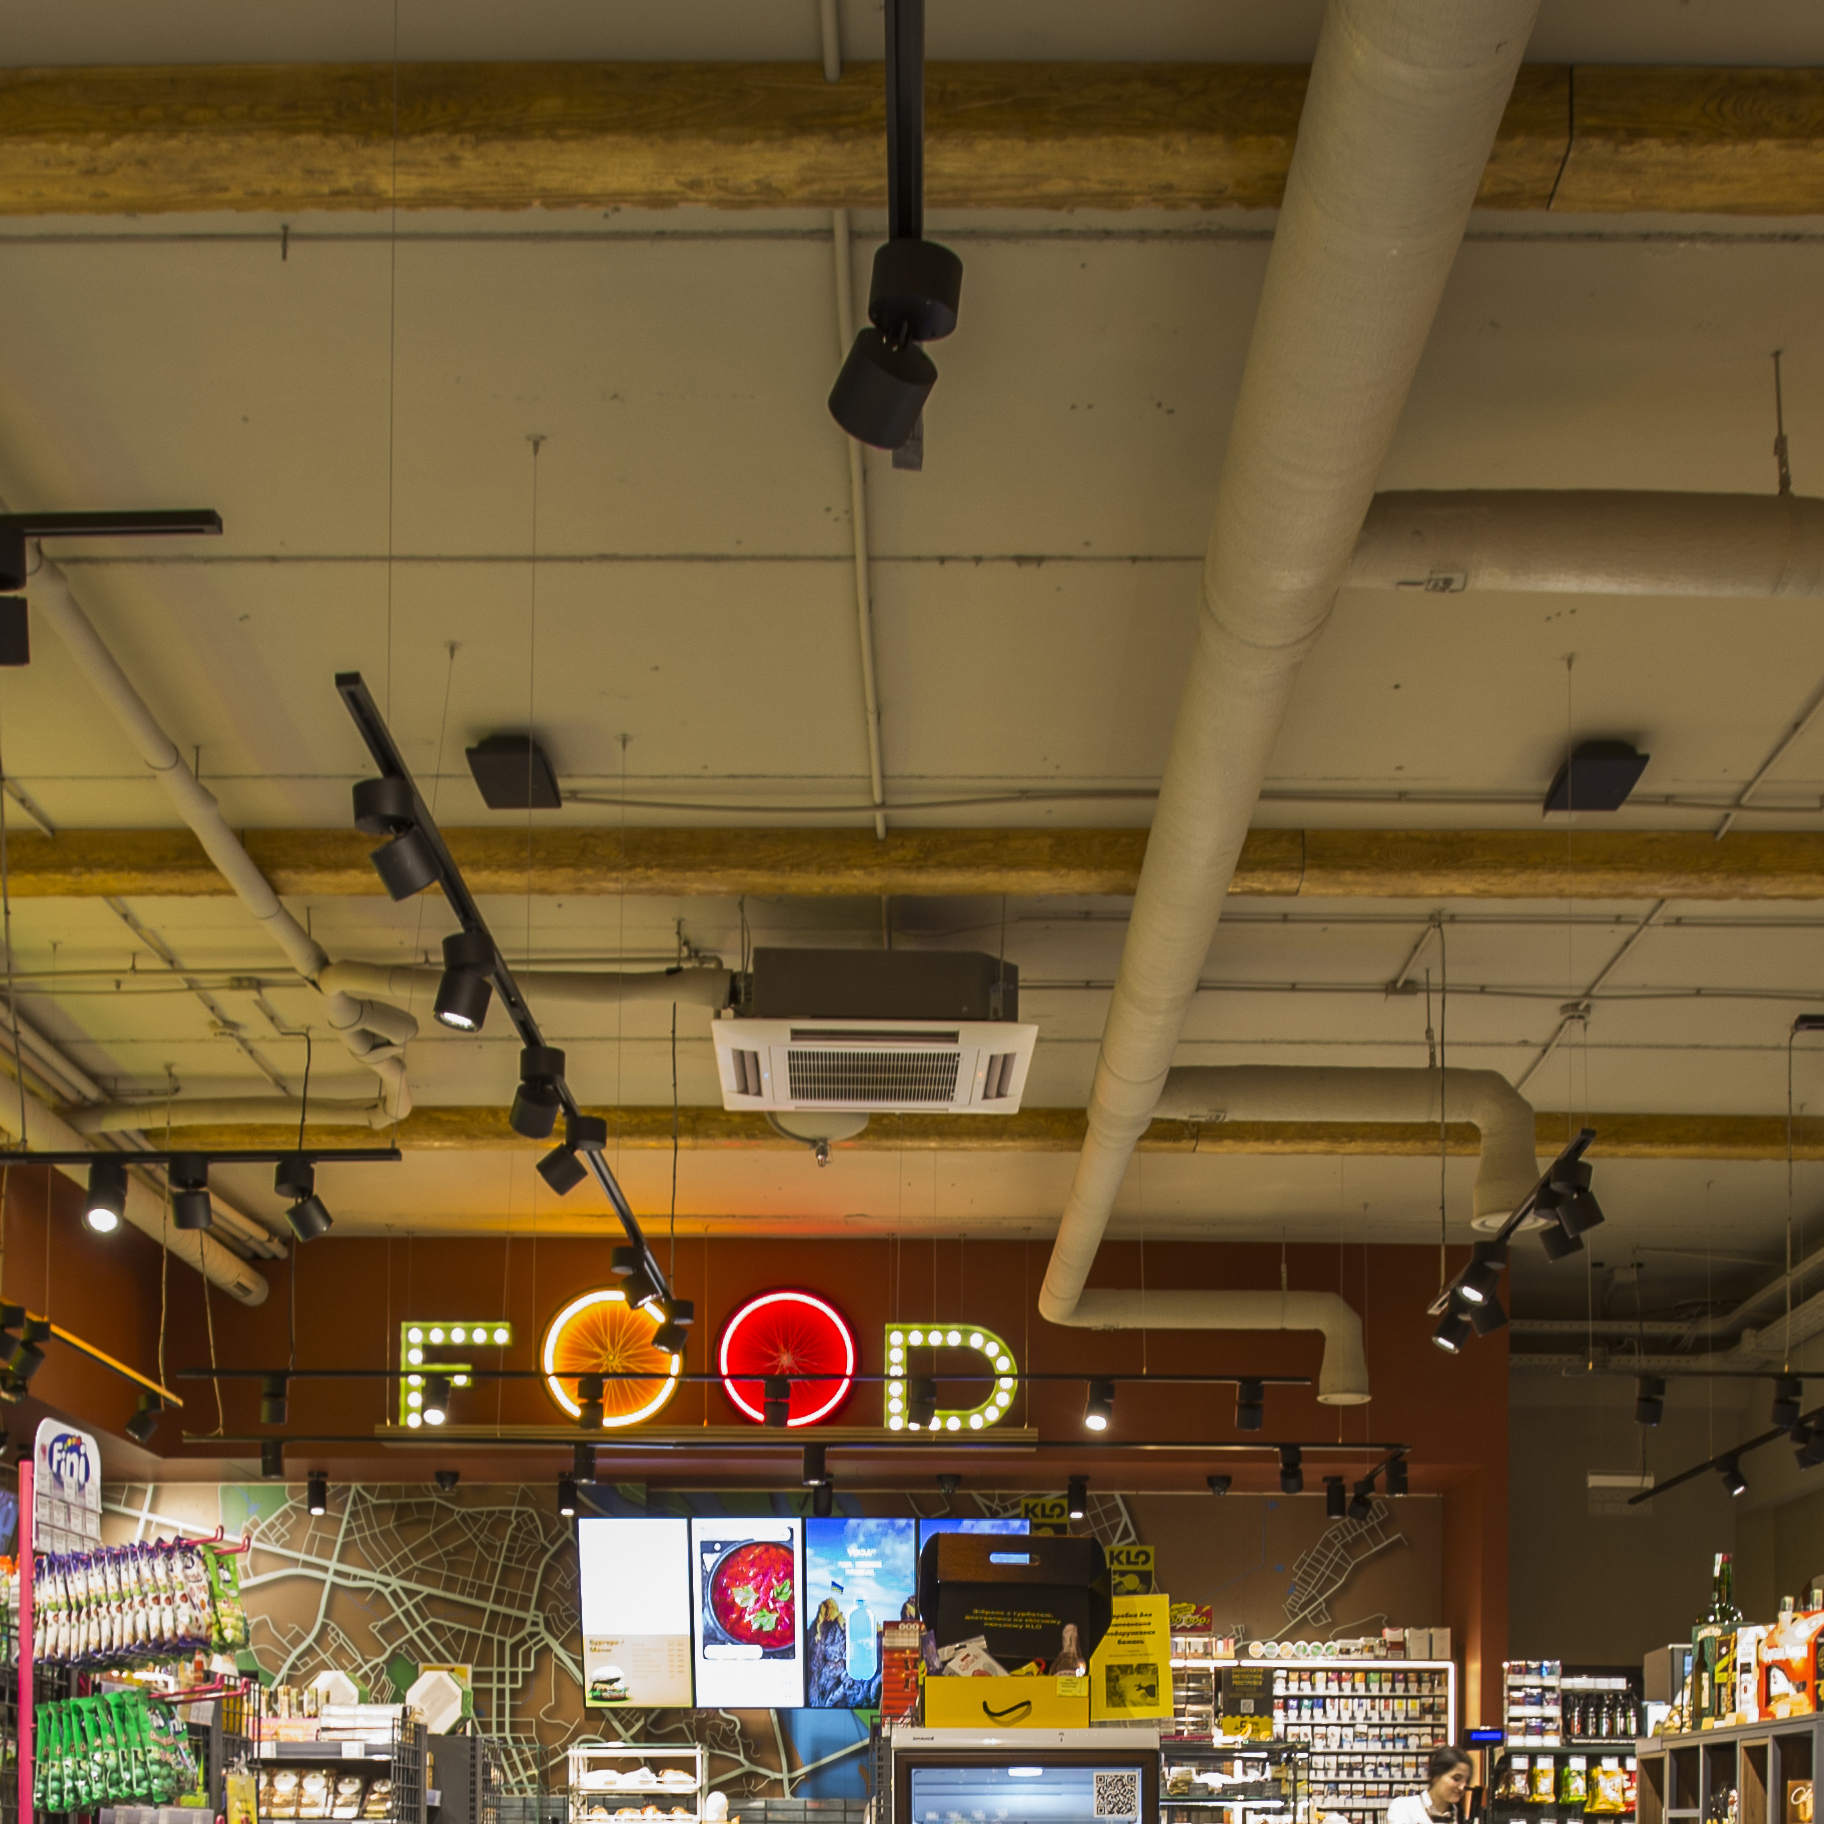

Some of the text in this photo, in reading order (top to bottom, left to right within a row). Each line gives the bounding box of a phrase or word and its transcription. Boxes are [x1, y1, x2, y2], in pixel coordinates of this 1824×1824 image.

[52, 1442, 89, 1486] Fini
[1024, 1502, 1066, 1519] KLO
[1109, 1550, 1151, 1566] KLO
